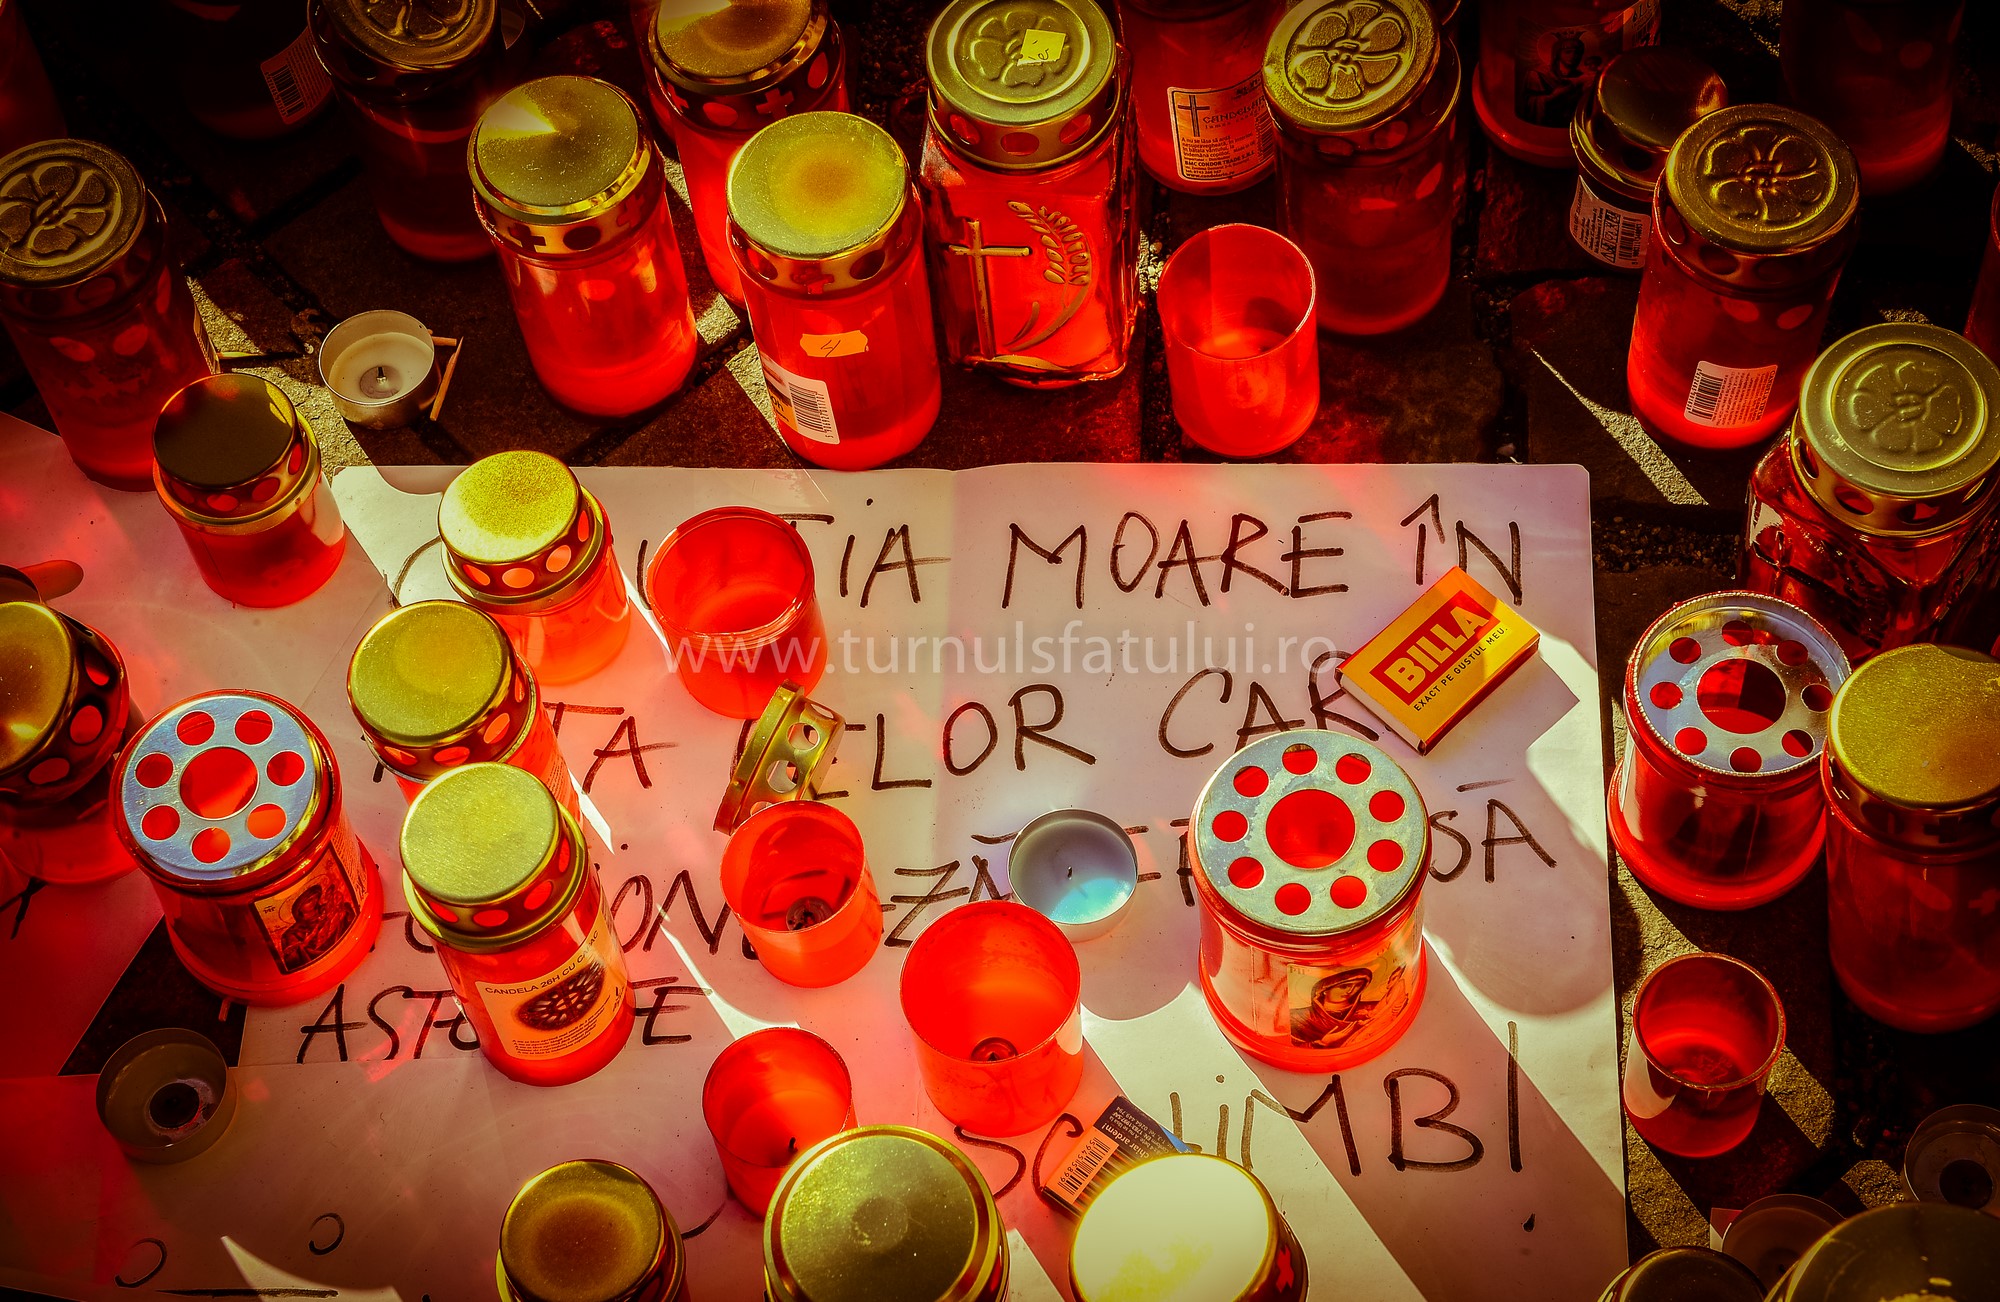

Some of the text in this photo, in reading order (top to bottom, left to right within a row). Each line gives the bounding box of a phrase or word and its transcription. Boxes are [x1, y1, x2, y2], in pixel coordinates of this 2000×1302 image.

[1001, 511, 1353, 609] MOARE
[1384, 606, 1490, 694] BILLA
[1413, 685, 1442, 712] EXACT
[1440, 673, 1455, 687] PE
[1453, 645, 1487, 675] GUSTUL
[485, 985, 539, 995] CANDELA
[540, 974, 561, 989] 26H
[562, 963, 576, 977] CU
[1101, 1122, 1131, 1147] ardem!
[1128, 1141, 1150, 1161] chiar
